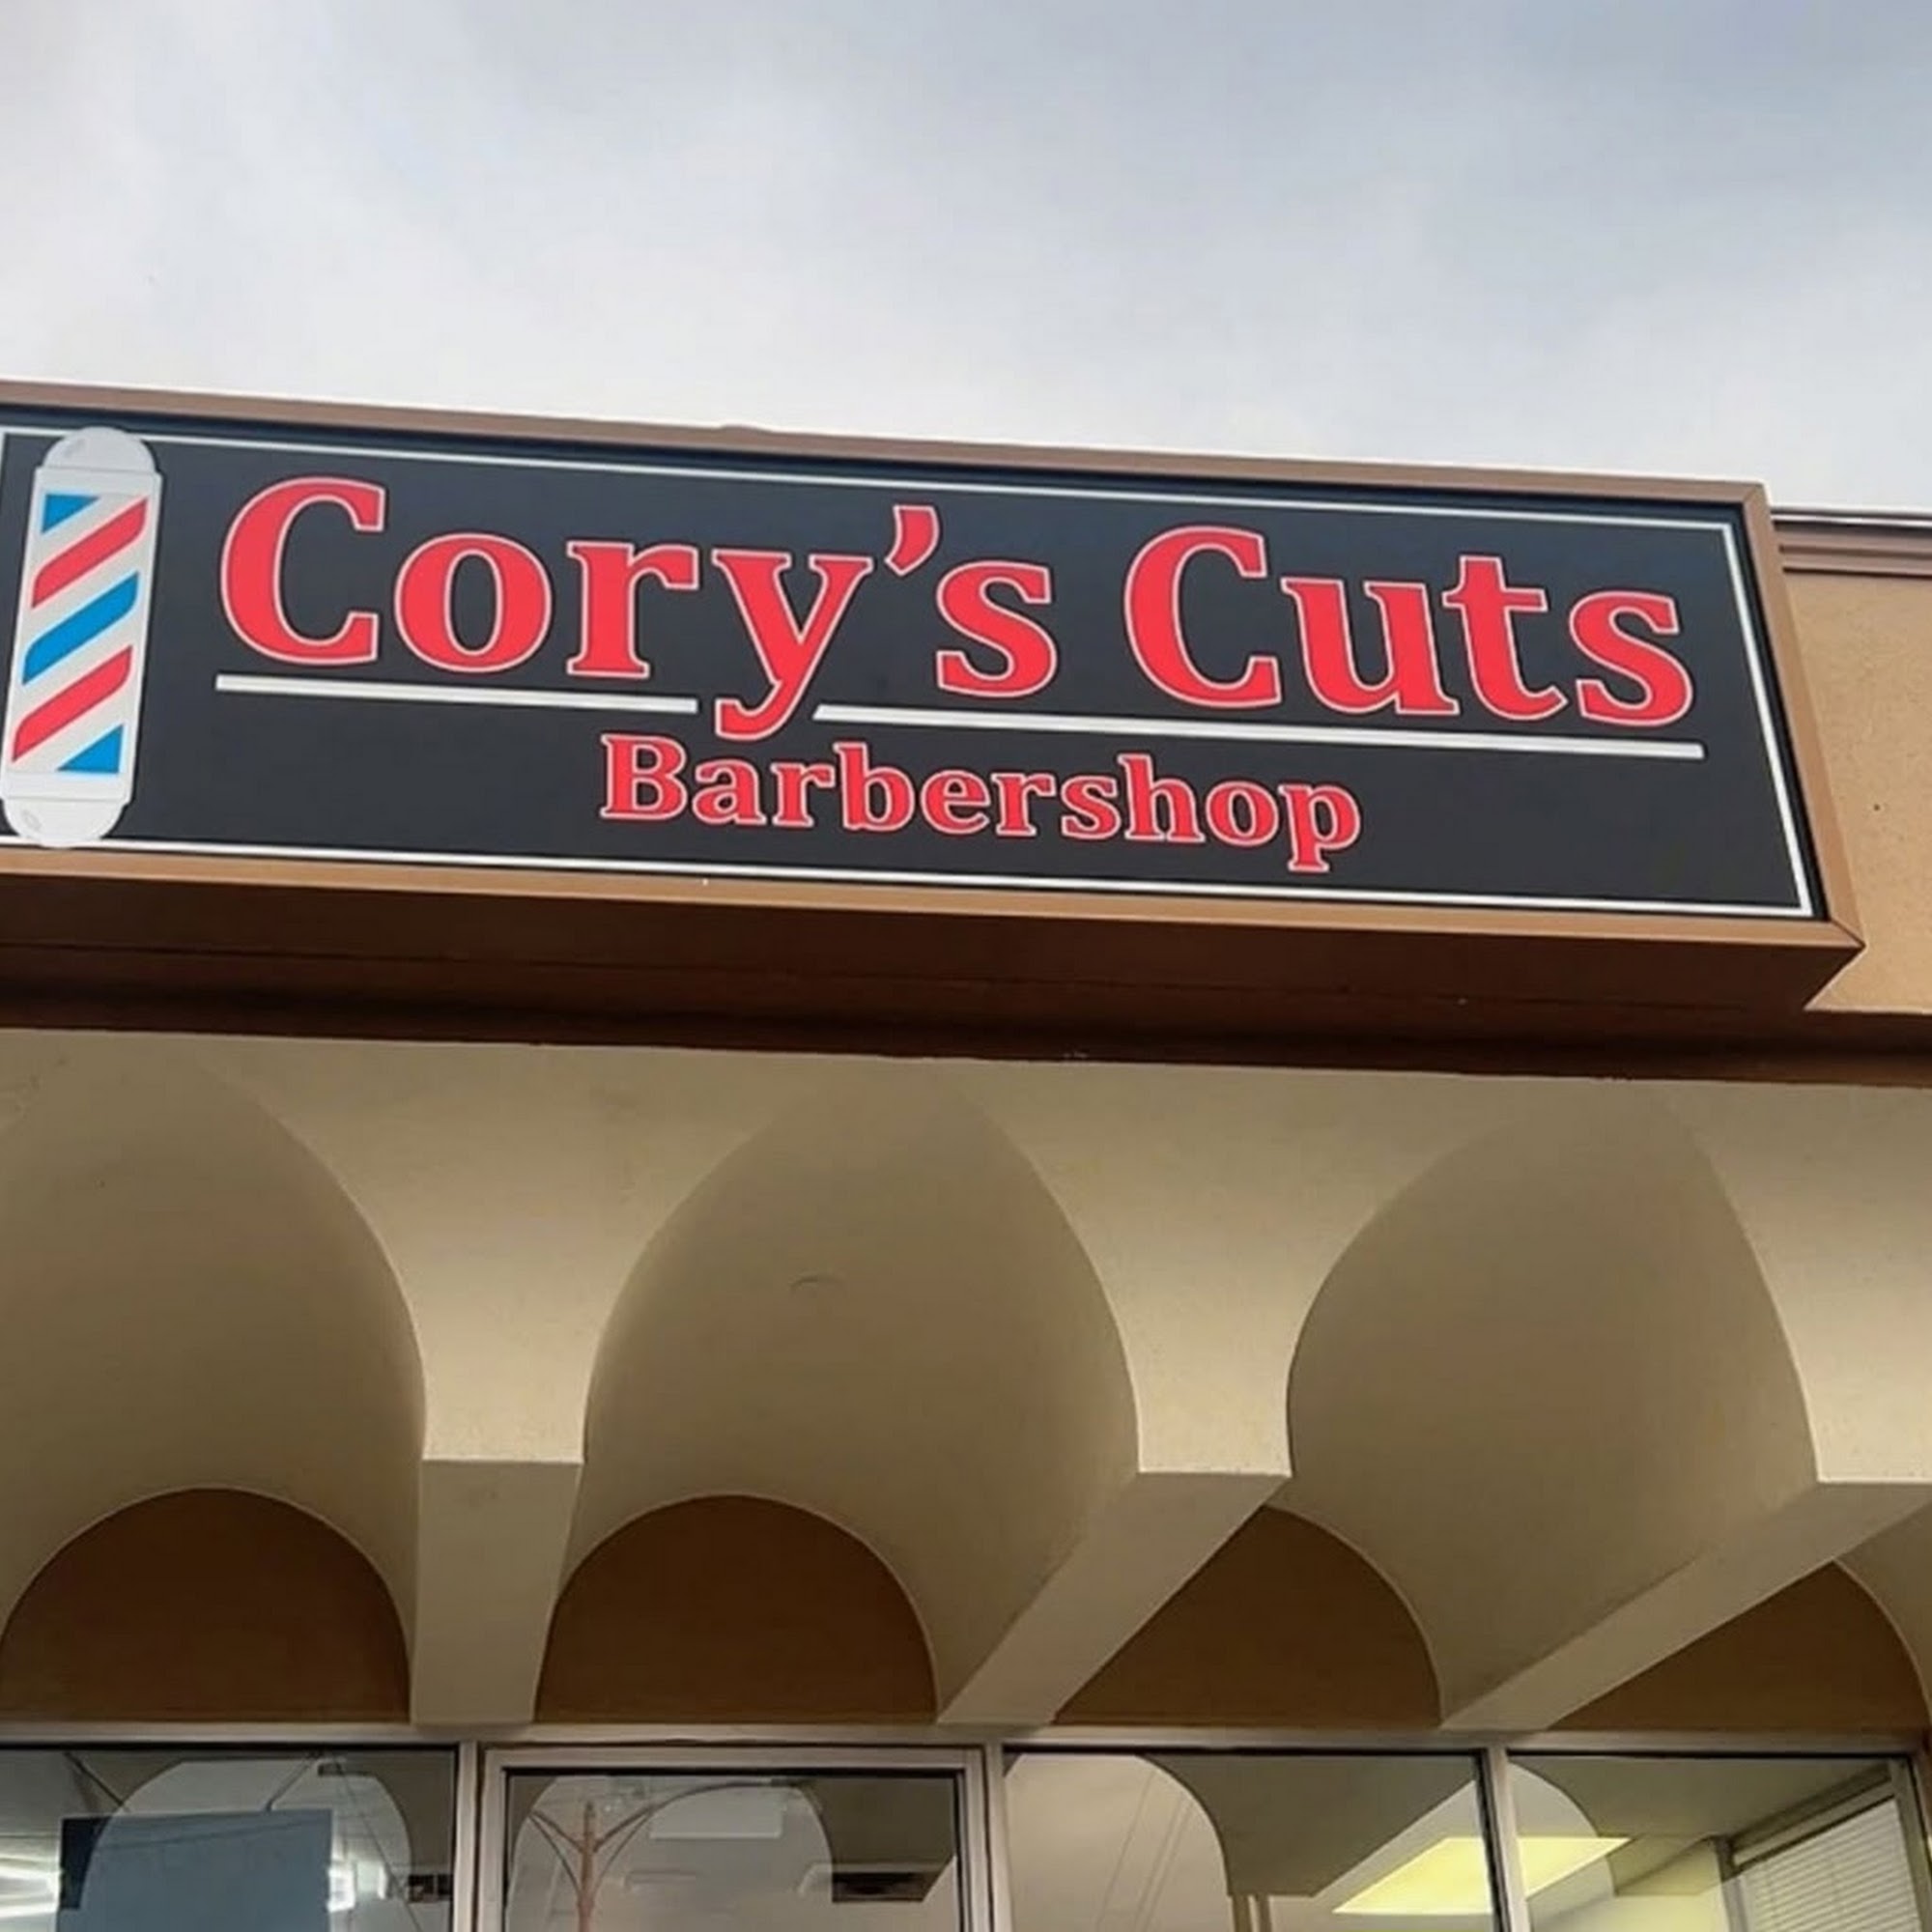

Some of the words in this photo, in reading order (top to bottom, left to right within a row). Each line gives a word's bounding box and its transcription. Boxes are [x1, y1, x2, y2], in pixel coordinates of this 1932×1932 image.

[220, 477, 1057, 740] Cory's
[1123, 526, 1694, 727] Cuts
[600, 733, 1360, 872] Barbershop
